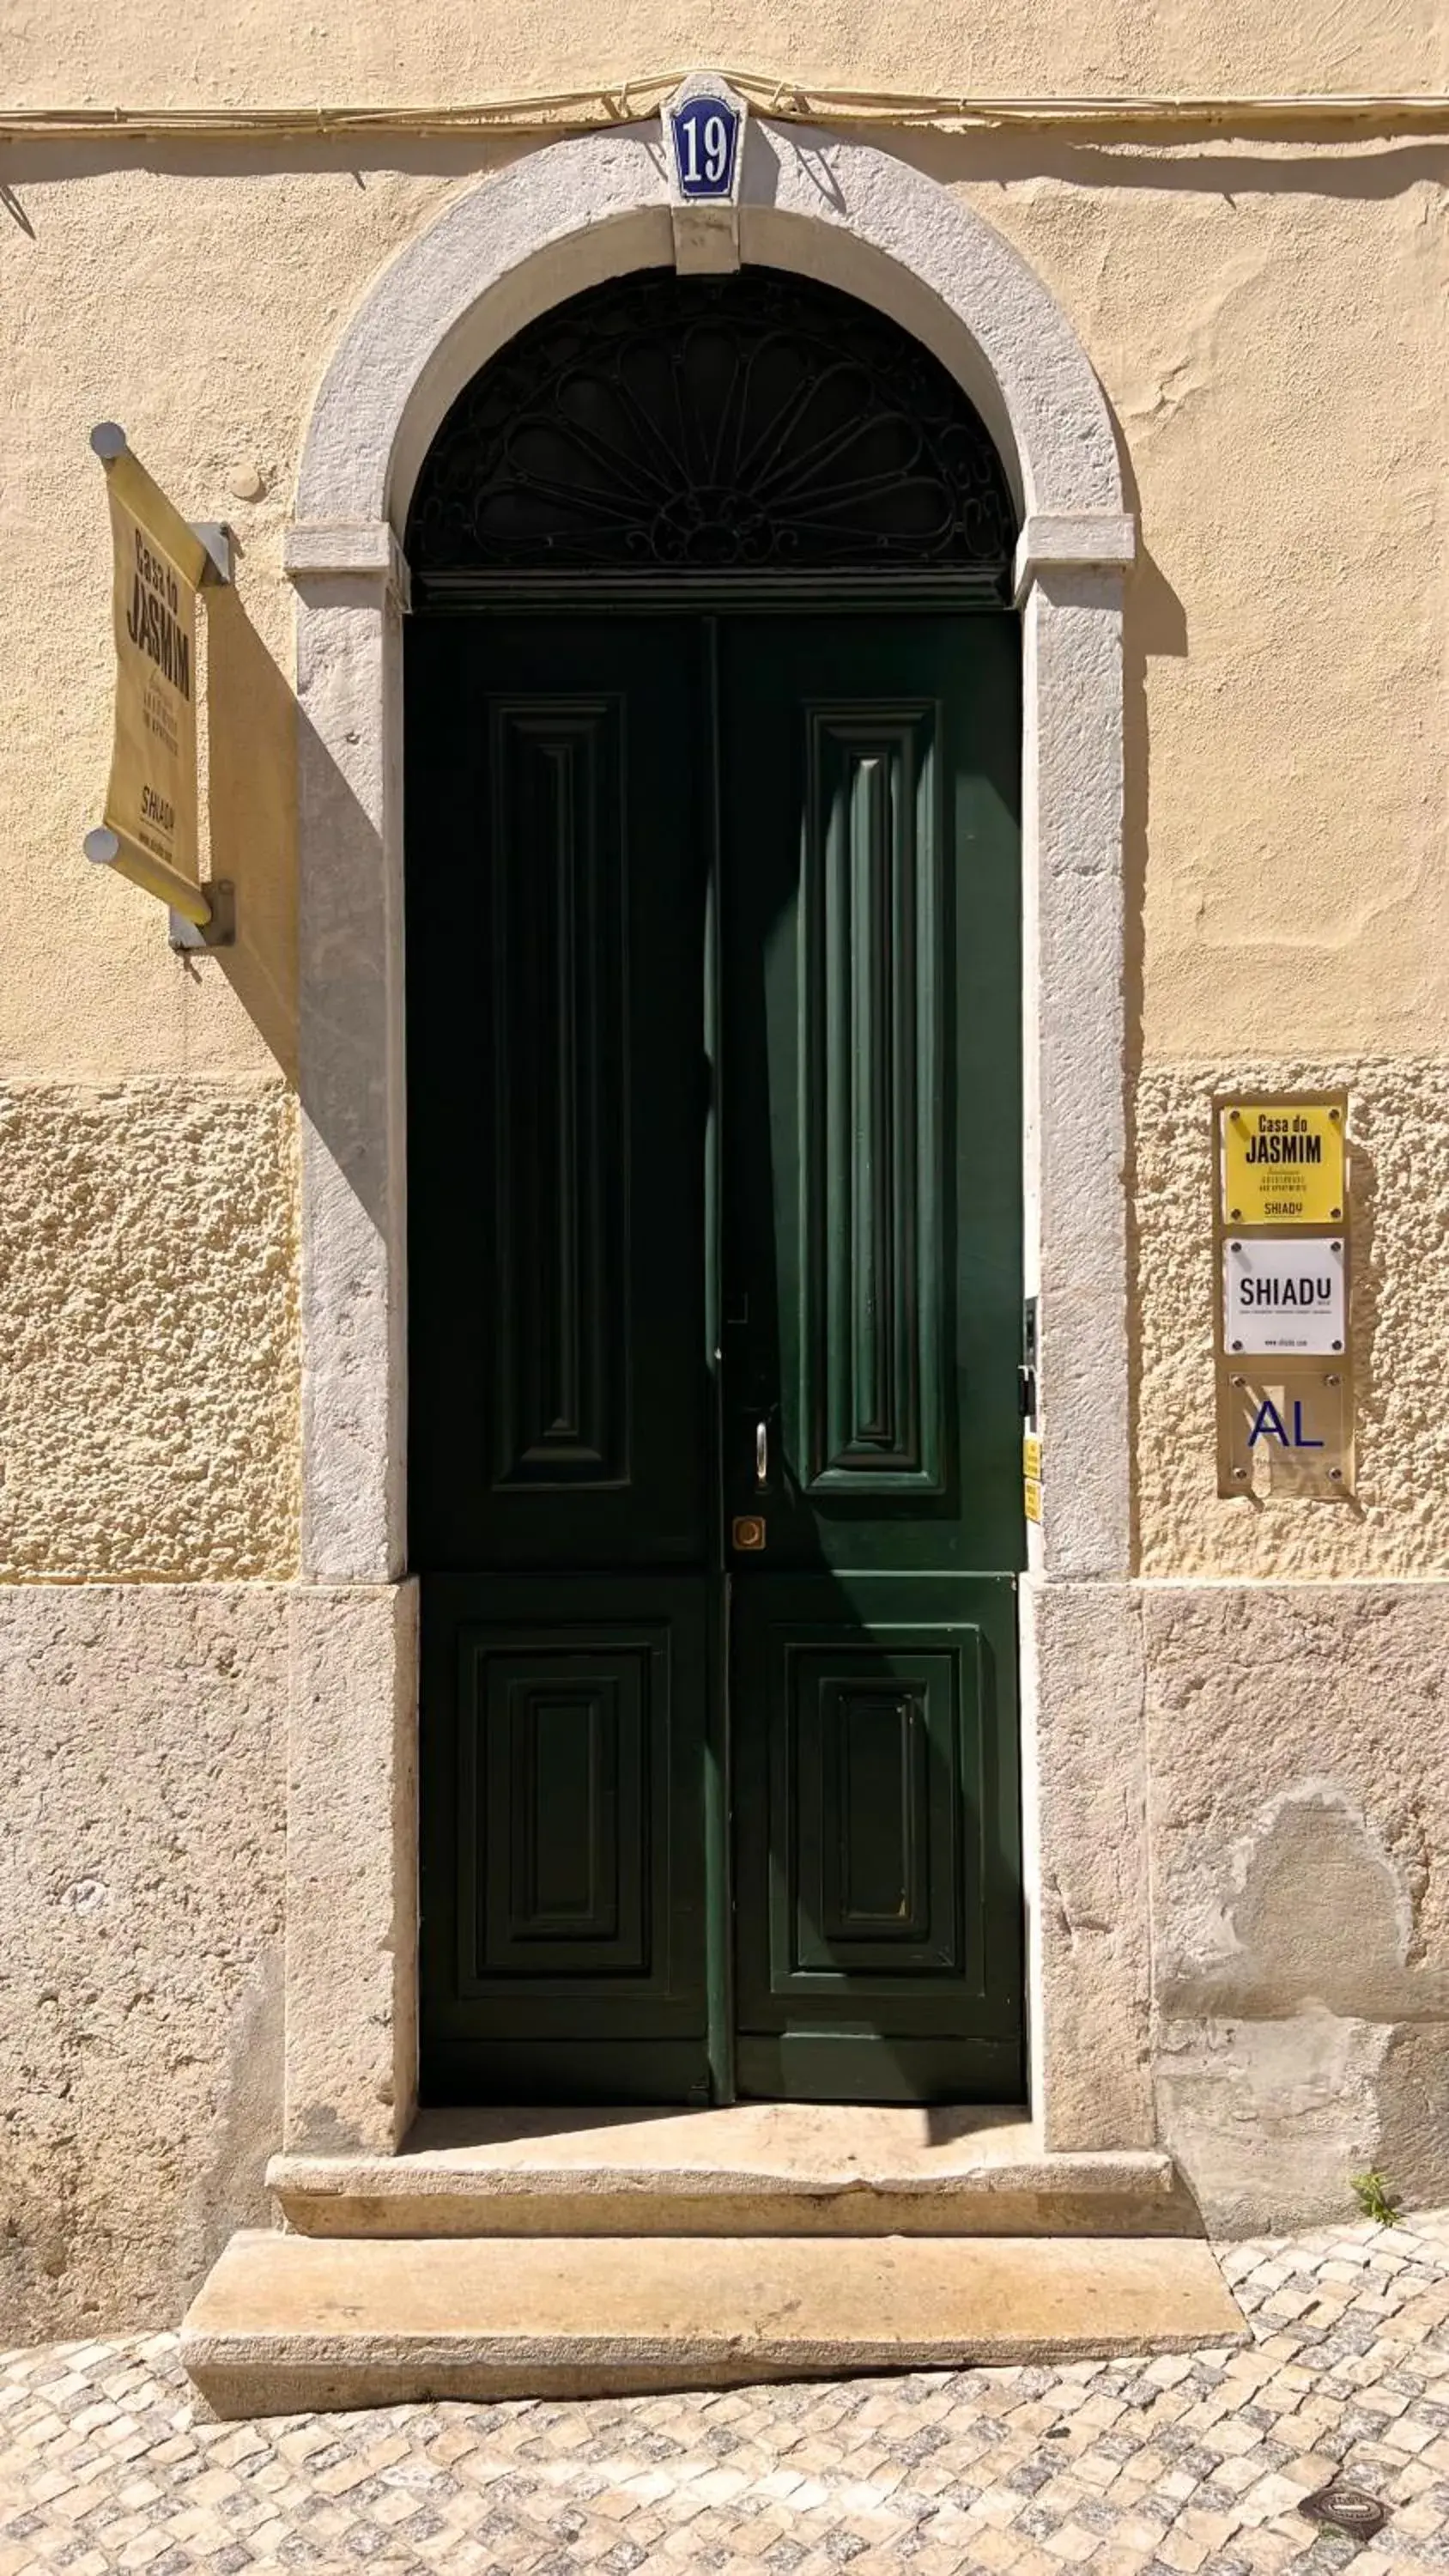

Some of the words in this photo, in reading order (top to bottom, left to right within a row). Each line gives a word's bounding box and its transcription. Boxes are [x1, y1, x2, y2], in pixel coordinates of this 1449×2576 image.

[682, 115, 728, 183] 19
[135, 527, 166, 598] Casa
[126, 573, 191, 702] JASMIM
[1258, 1114, 1288, 1133] Casa
[1293, 1114, 1307, 1133] do
[1246, 1135, 1321, 1163] JASMIM
[1264, 1202, 1303, 1215] SHIADU
[1240, 1278, 1331, 1306] SHIADU
[1247, 1400, 1325, 1447] AL
